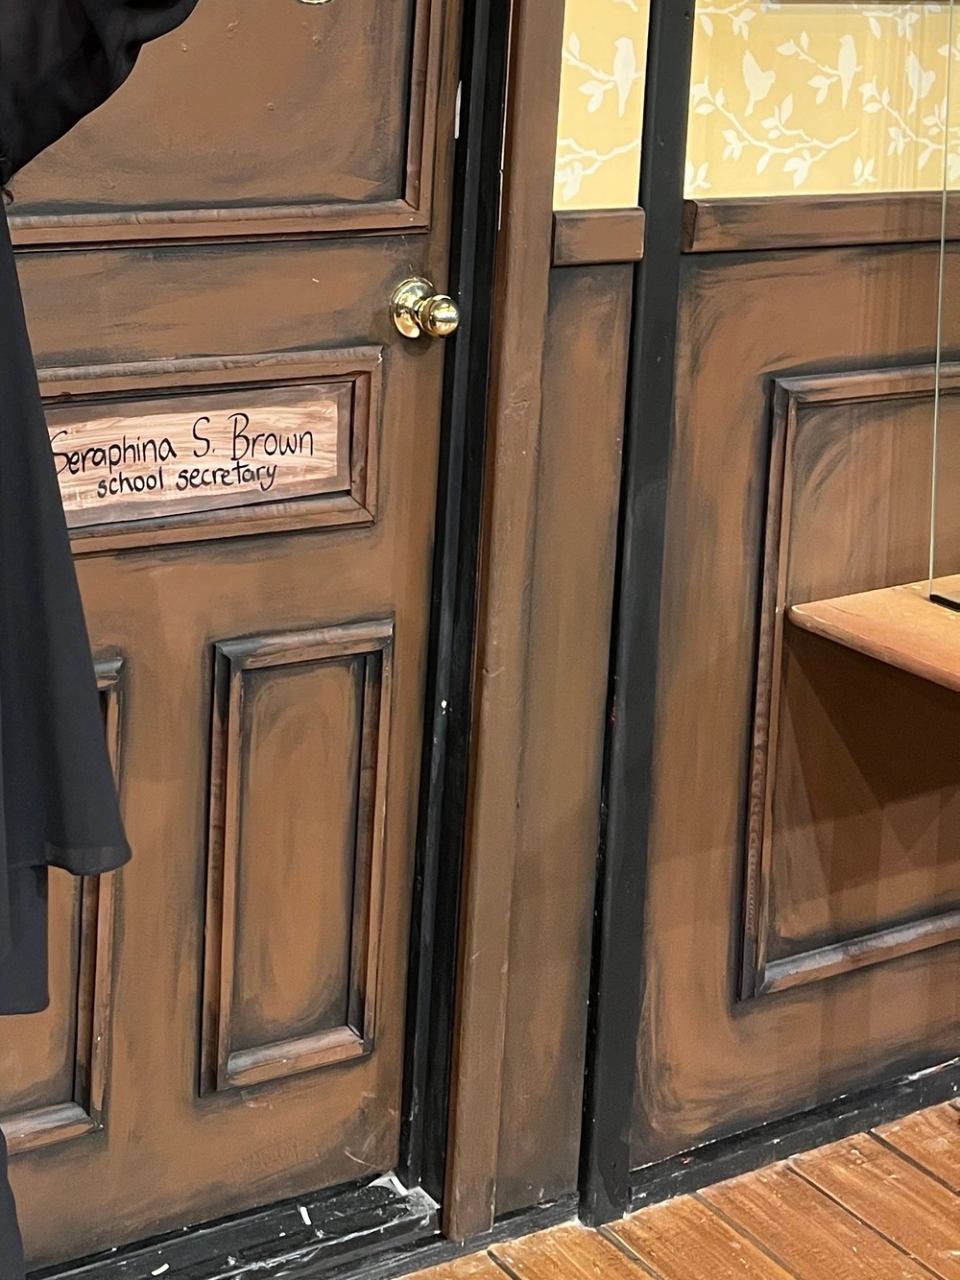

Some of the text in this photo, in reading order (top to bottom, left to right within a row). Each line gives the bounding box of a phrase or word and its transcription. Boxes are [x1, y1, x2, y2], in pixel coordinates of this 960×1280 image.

[51, 412, 314, 475] Seraphina S. Brown
[96, 461, 278, 498] school secretary
